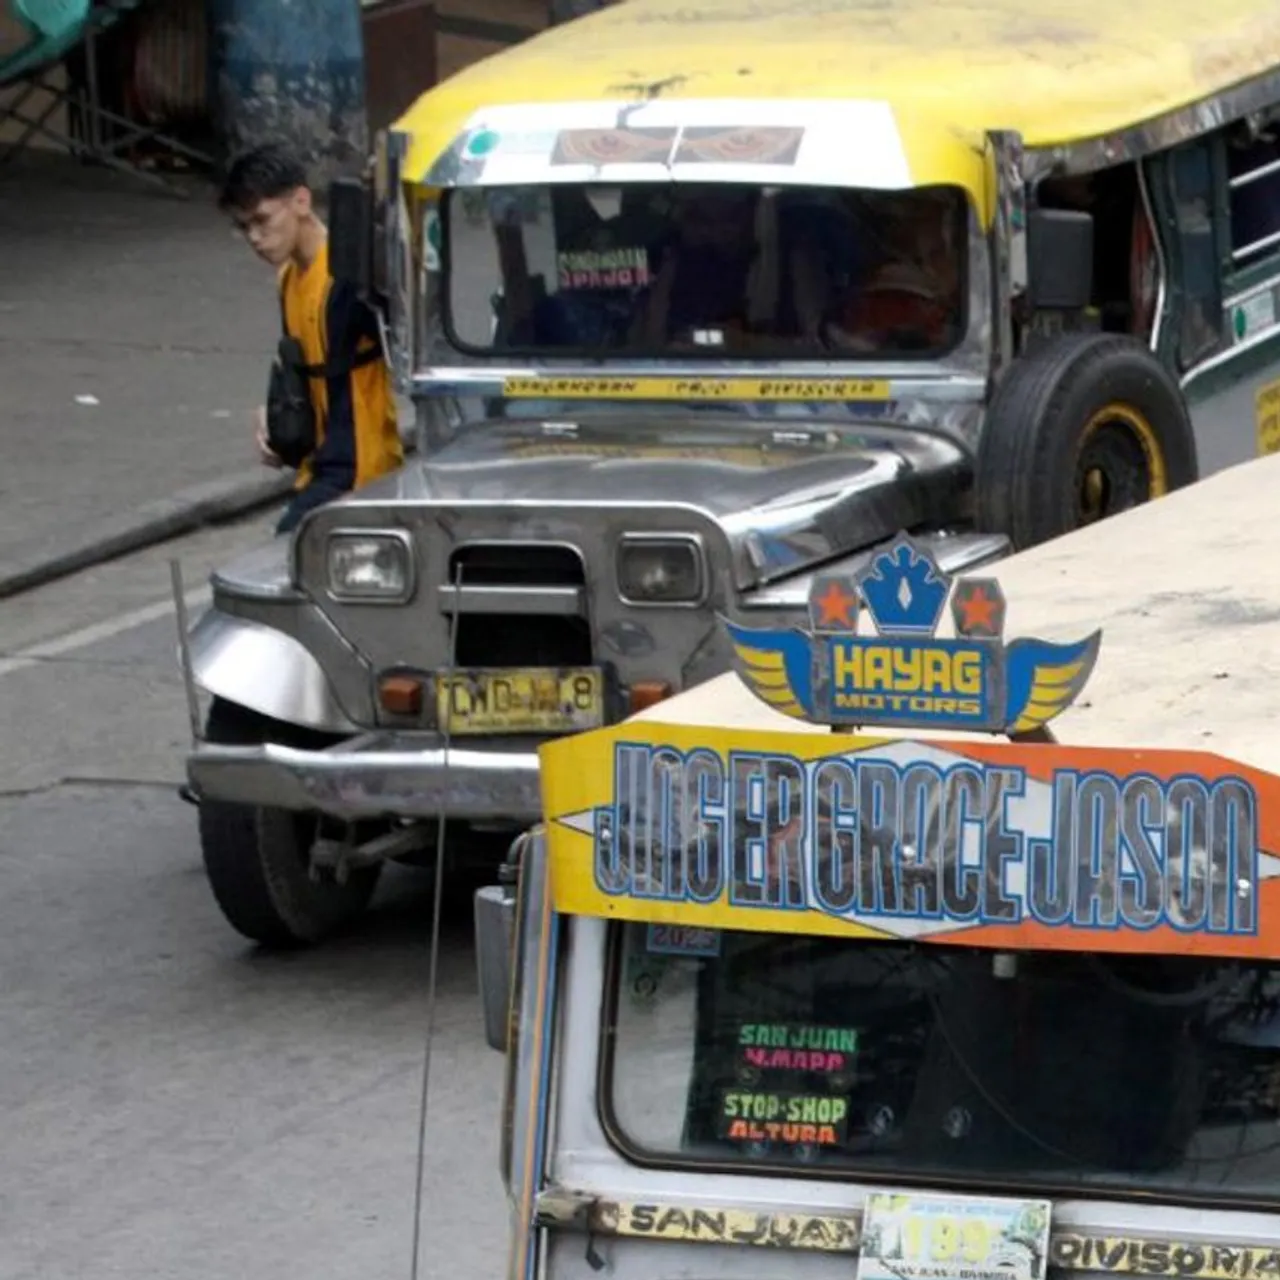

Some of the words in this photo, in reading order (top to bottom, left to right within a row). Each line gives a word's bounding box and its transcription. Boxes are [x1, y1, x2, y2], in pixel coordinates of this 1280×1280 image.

[834, 644, 981, 694] HAYAG
[835, 692, 981, 715] MOTORS
[811, 757, 1026, 924] GRACE
[1026, 767, 1259, 935] JASON
[739, 1024, 788, 1047] SAN
[790, 1027, 859, 1051] JUAN
[728, 1120, 840, 1144] ALTURA
[630, 1205, 726, 1237] SAN
[731, 1212, 855, 1247] JUAN
